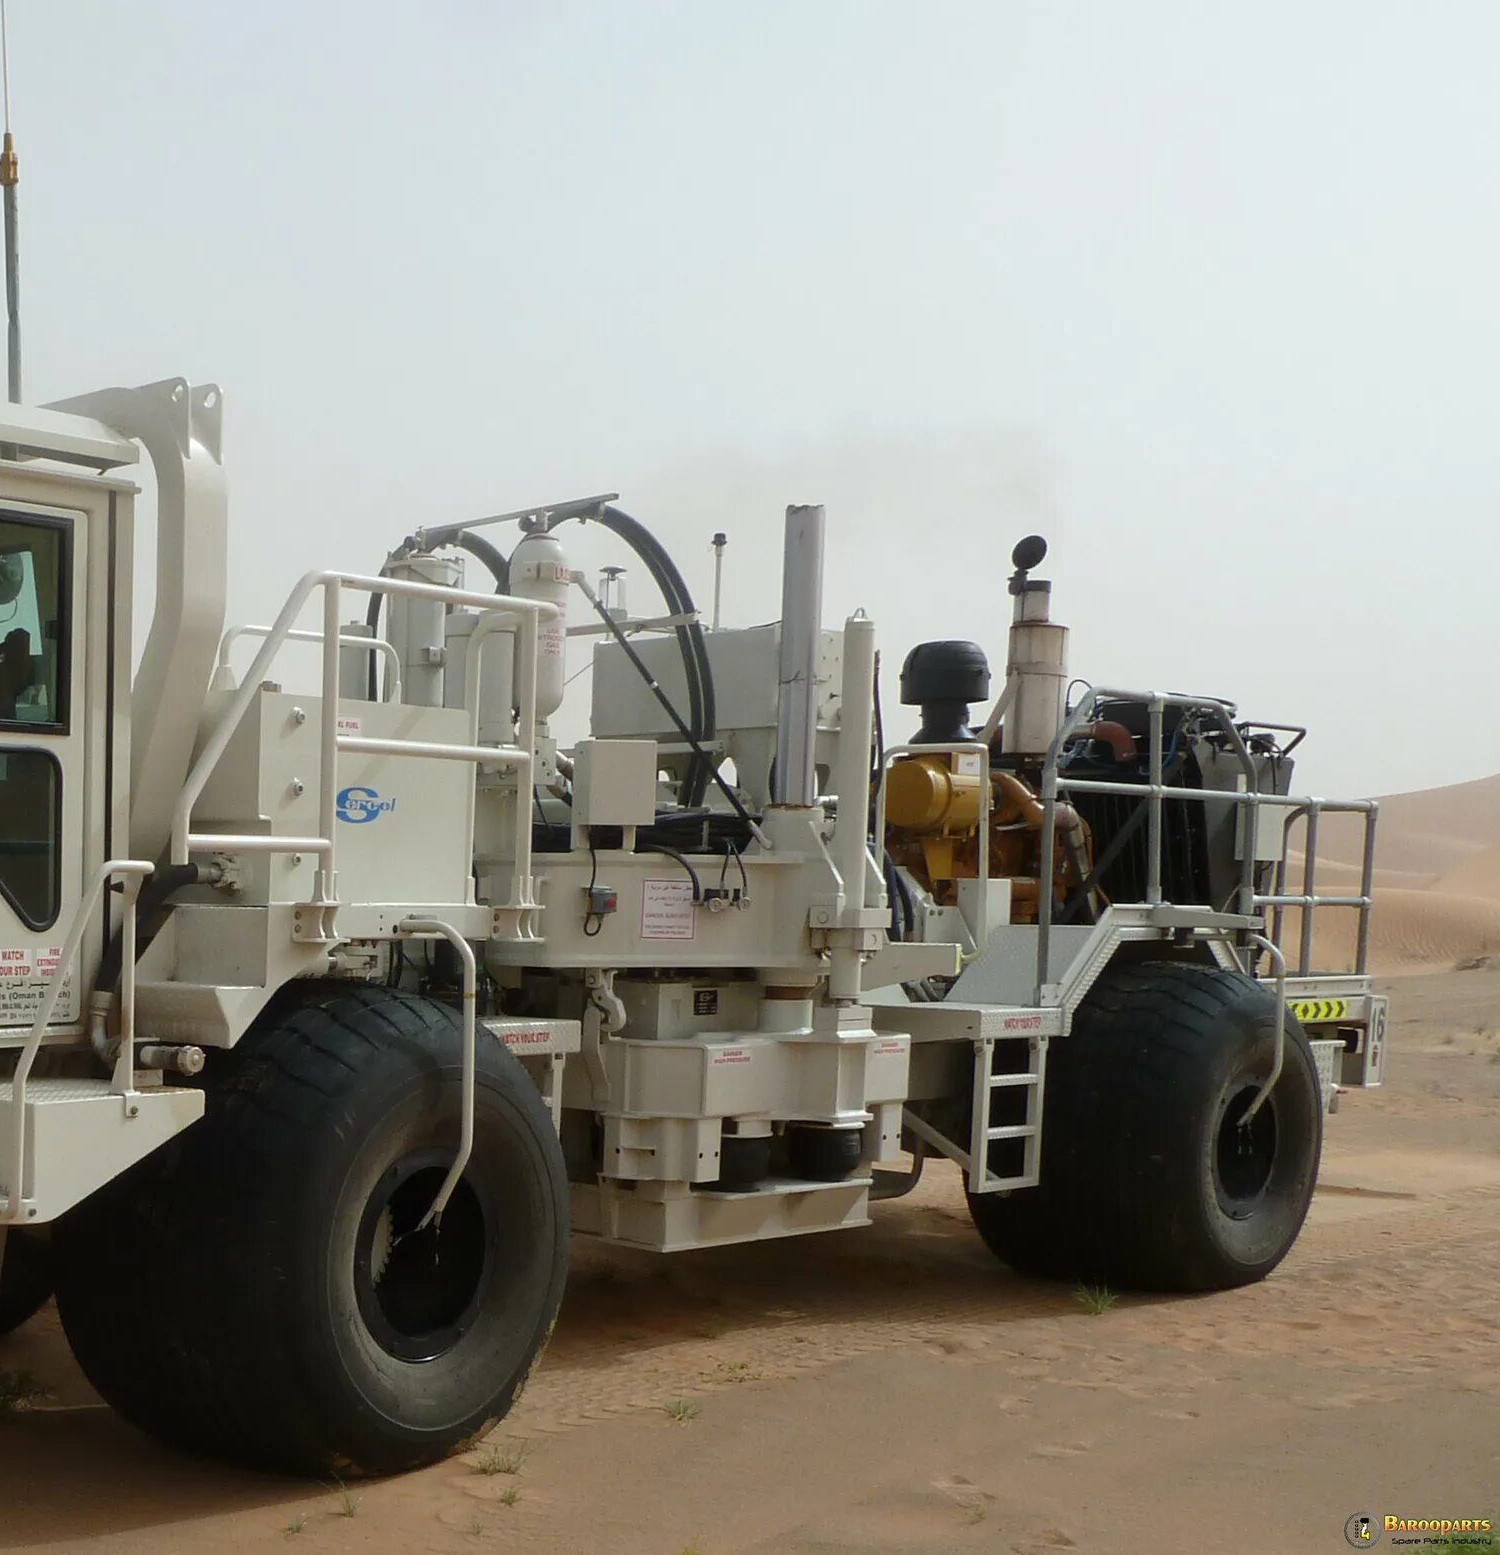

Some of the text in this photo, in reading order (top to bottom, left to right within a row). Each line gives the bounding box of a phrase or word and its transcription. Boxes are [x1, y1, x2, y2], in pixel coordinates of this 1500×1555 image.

[336, 787, 396, 824] Sercel
[2, 951, 25, 960] WATCH
[14, 966, 31, 976] STEP
[1371, 1006, 1386, 1042] 16
